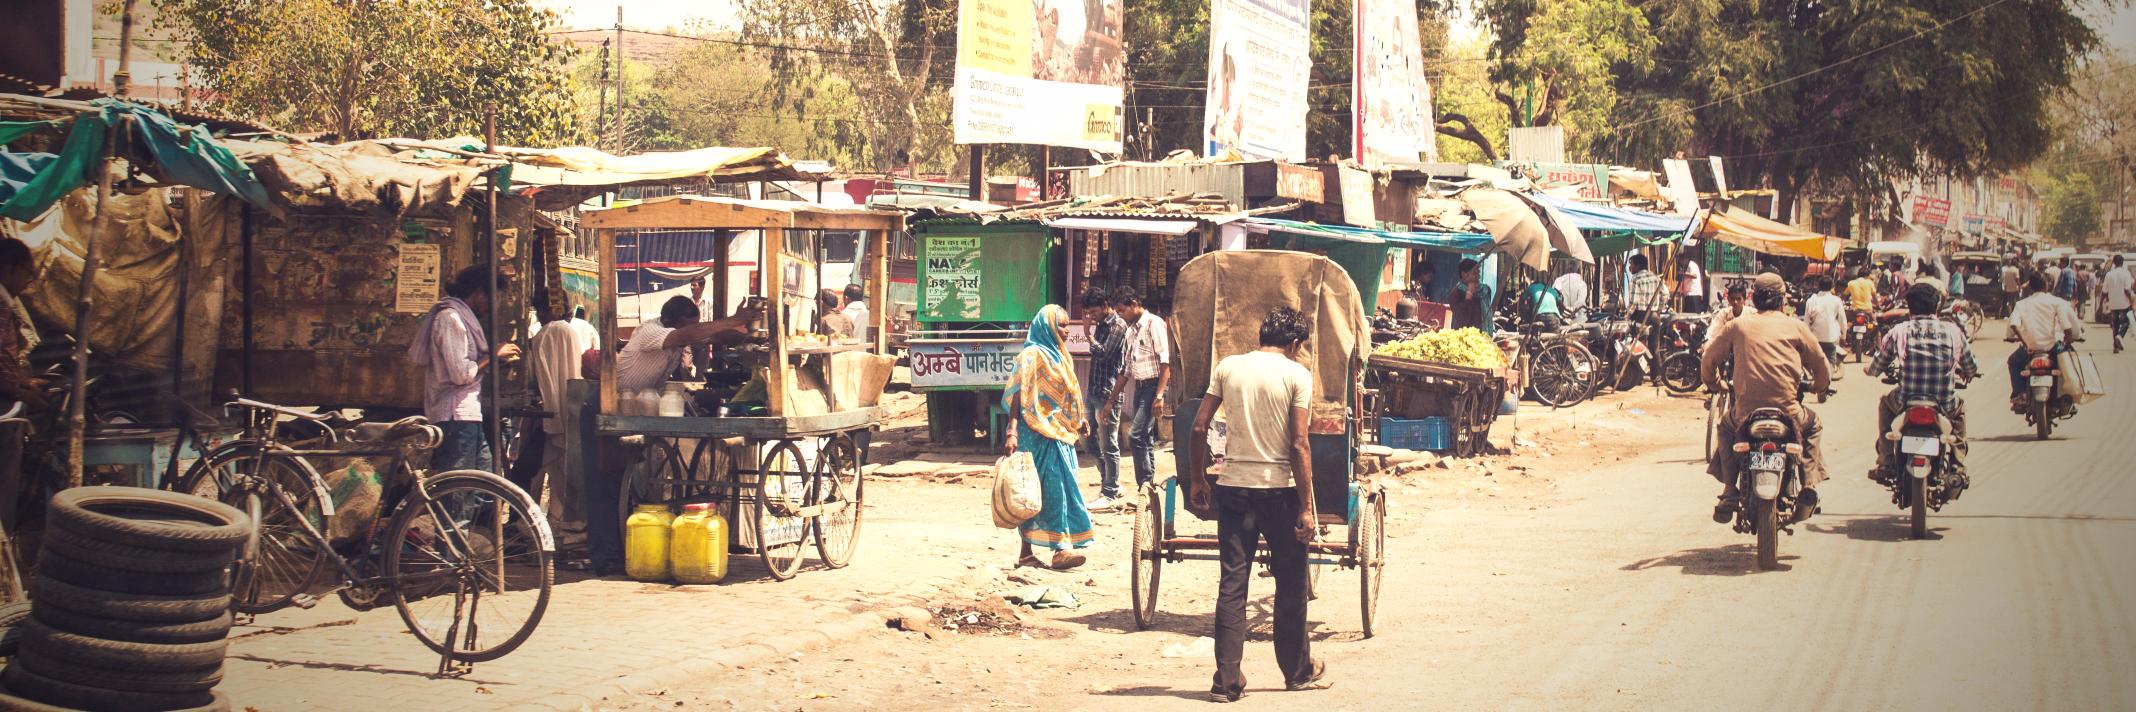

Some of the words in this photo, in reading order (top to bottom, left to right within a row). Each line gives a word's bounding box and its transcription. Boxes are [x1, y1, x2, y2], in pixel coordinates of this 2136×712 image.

[913, 346, 962, 376] अम्बे
[964, 353, 988, 374] पान
[990, 346, 1018, 373] भंड
